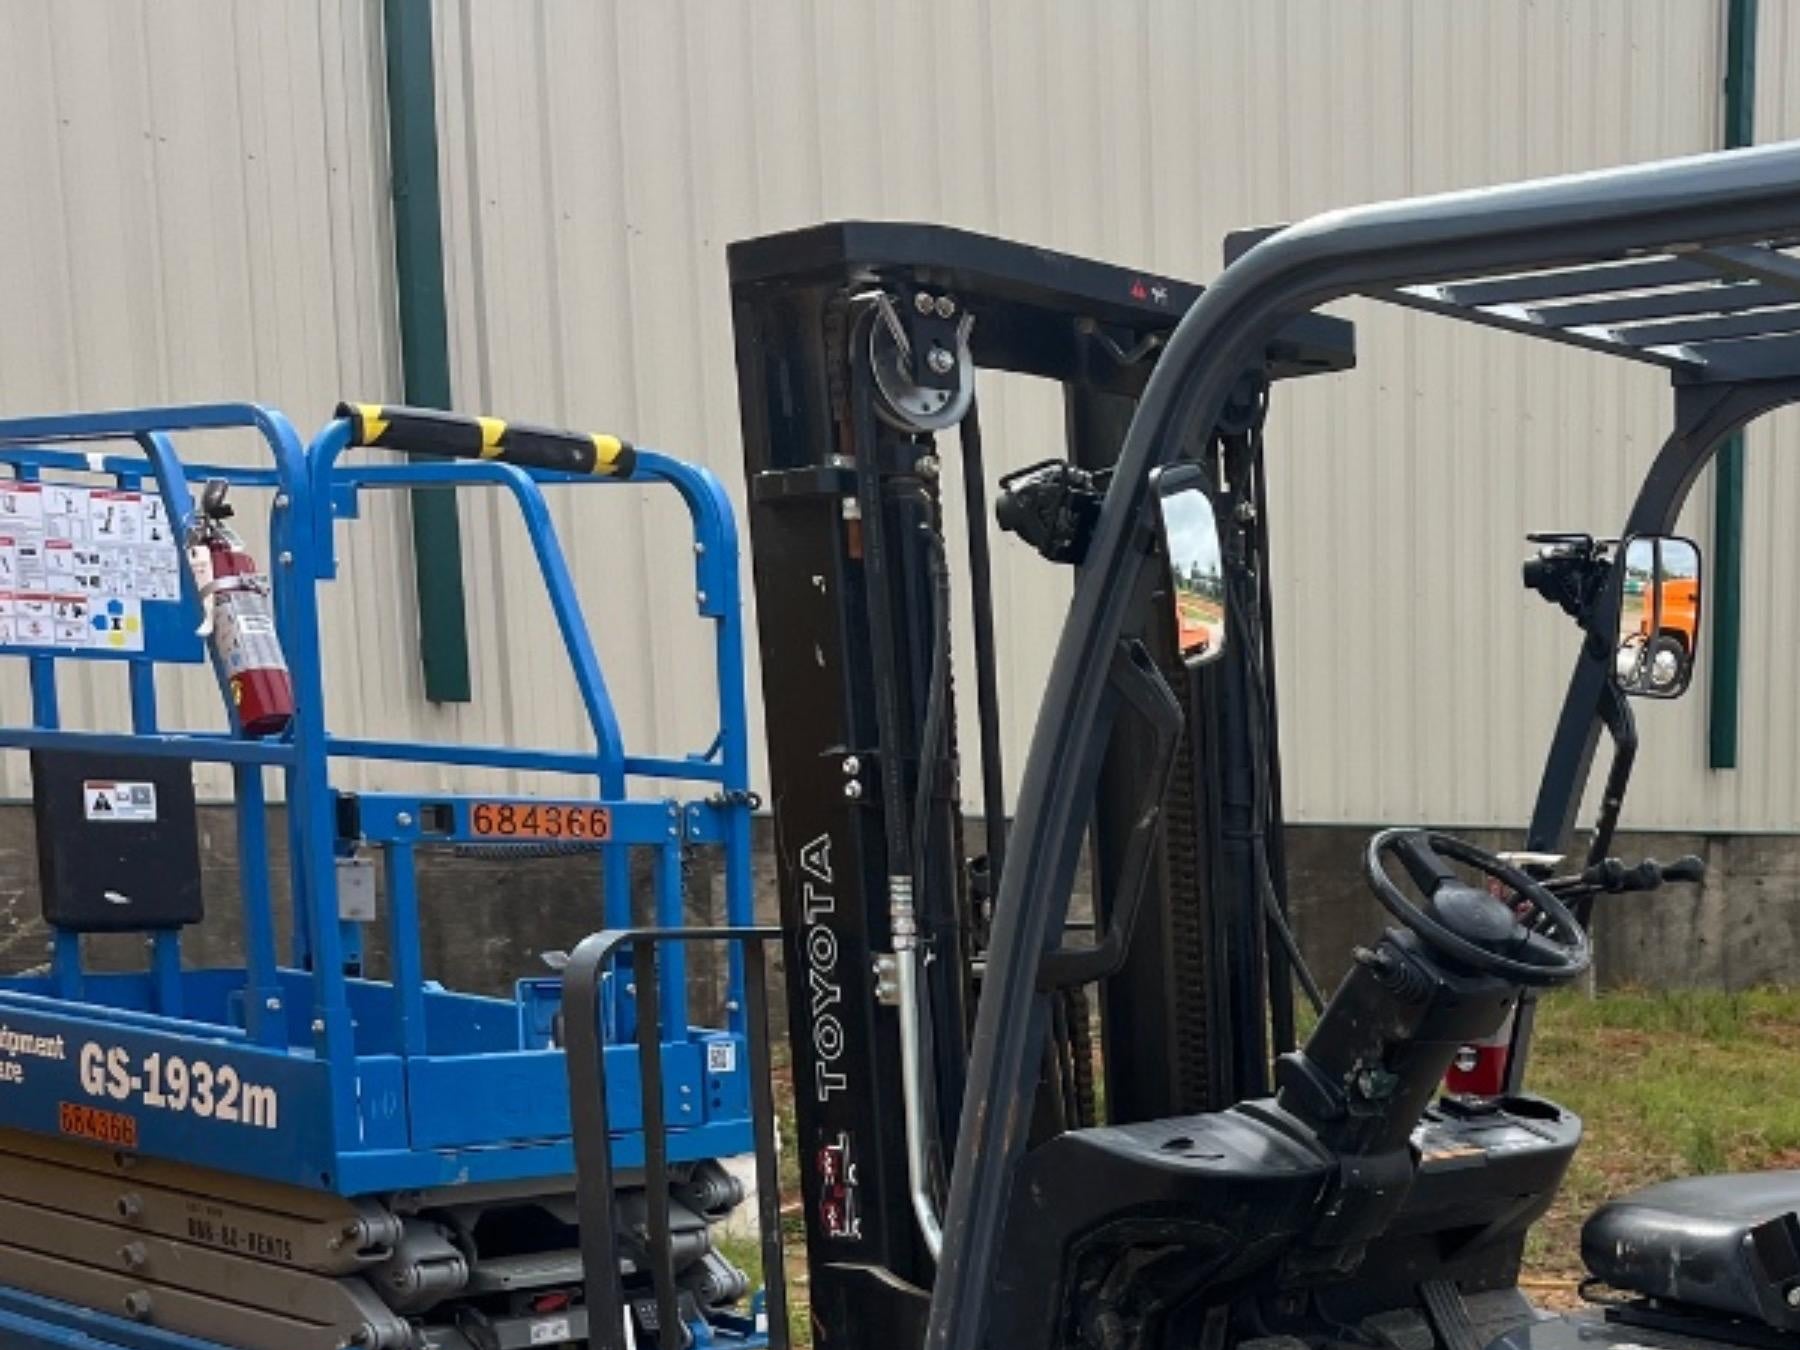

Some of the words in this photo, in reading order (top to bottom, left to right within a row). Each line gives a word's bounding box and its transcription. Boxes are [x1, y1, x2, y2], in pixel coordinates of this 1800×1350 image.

[473, 803, 608, 838] 684366
[801, 832, 848, 1102] TOYOTA
[80, 1041, 278, 1129] GS-1932m
